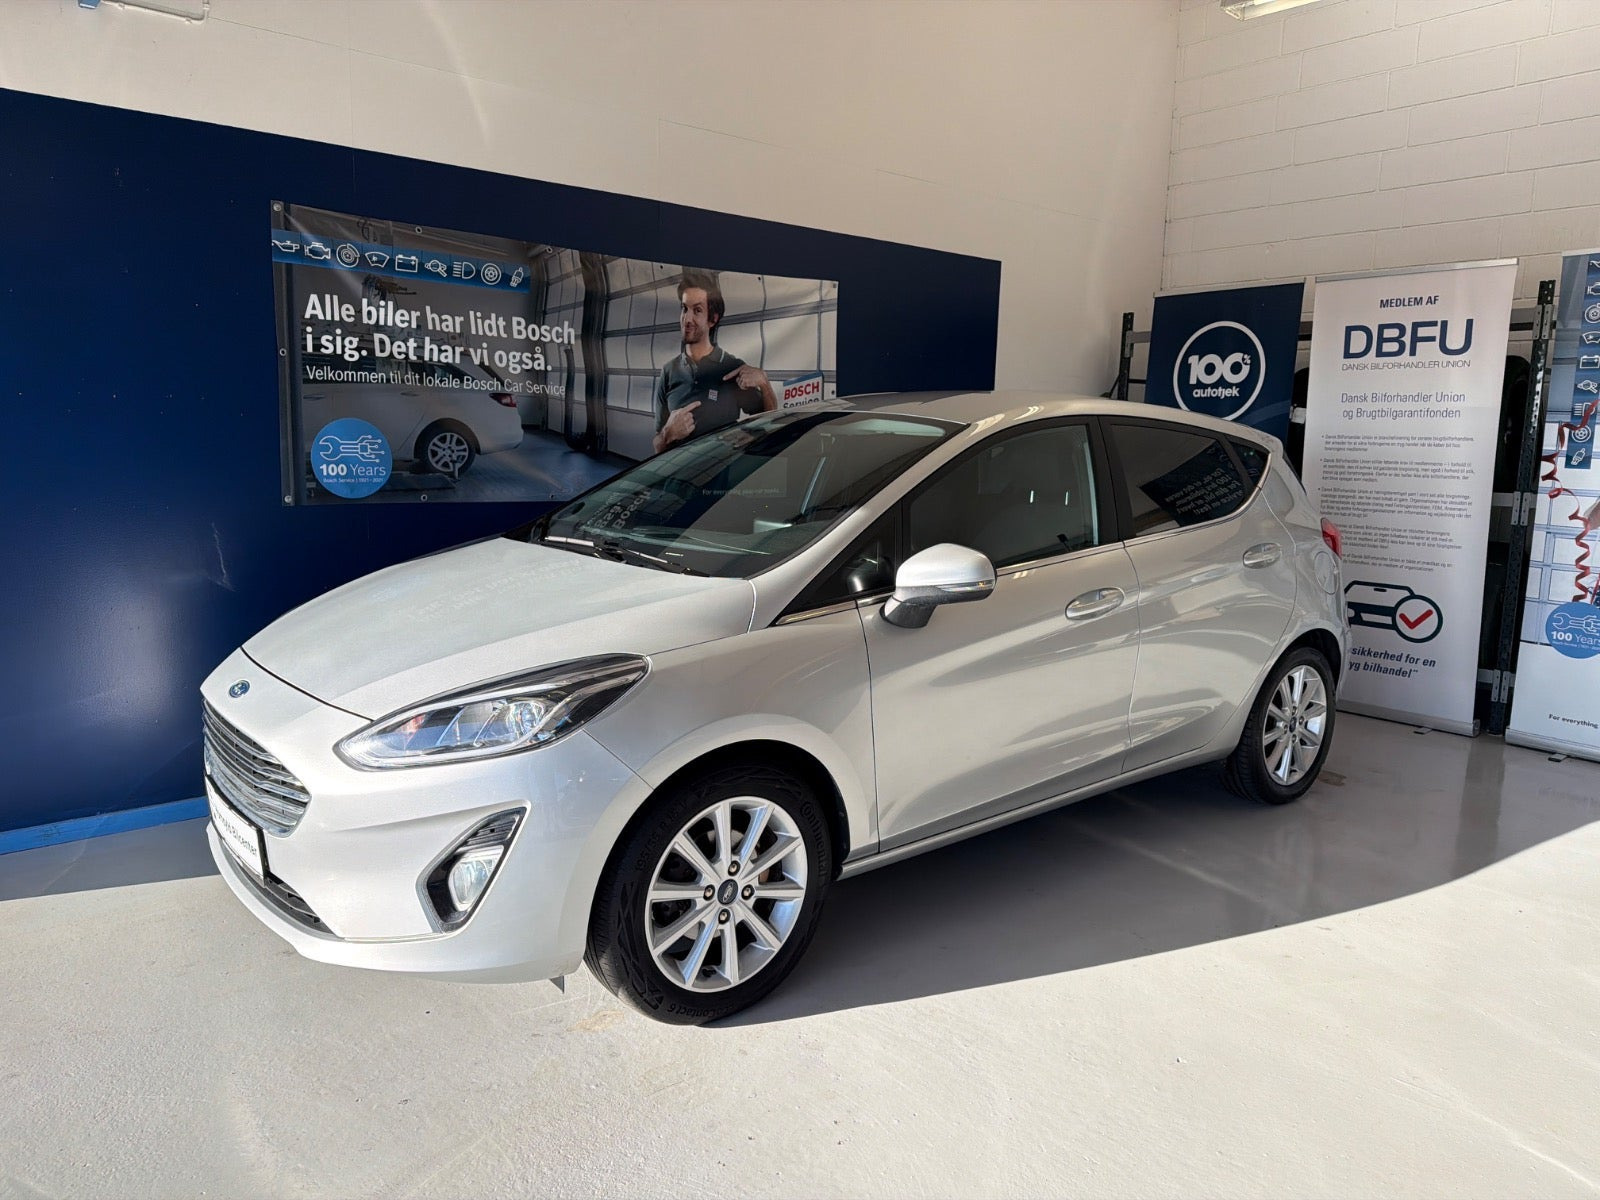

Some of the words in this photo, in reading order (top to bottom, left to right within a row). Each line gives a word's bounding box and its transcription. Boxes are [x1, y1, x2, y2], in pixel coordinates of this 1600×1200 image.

[1379, 296, 1424, 309] MEDLEM
[1425, 295, 1440, 306] AF
[304, 293, 355, 323] Alle
[361, 297, 421, 329] biler
[425, 305, 465, 334] har
[468, 310, 508, 338] lidt
[511, 316, 576, 345] Bosch
[1343, 318, 1474, 360] DBFU
[305, 326, 313, 353] i
[320, 328, 368, 362] sig.
[373, 332, 418, 361] Det
[424, 336, 465, 364] har
[468, 342, 489, 366] vi
[494, 346, 553, 375] også.
[1341, 362, 1370, 371] DANSK
[1370, 360, 1440, 371] BILFORHANDLER
[1440, 359, 1471, 369] UNION
[305, 365, 386, 384] Velkommen
[389, 370, 402, 385] til
[403, 371, 421, 386] dit
[423, 372, 460, 389] lokale
[463, 375, 501, 391] Bosch
[503, 378, 524, 393] Car
[525, 381, 566, 396] Service
[784, 381, 820, 401] BOSCH
[1192, 386, 1240, 400] autotjek
[1341, 392, 1369, 404] Dansk
[1371, 391, 1433, 404] Bilforhandler
[1435, 391, 1466, 402] Union
[1342, 409, 1354, 420] og
[1356, 407, 1461, 421] Brugtbilgarantifonden
[320, 463, 347, 477] 100
[349, 463, 386, 476] Years
[1551, 630, 1573, 642] 100
[1351, 646, 1403, 662] sikkerhed
[1404, 653, 1420, 665] for
[1422, 659, 1437, 668] en
[1348, 661, 1361, 672] yg
[1548, 713, 1560, 721] For
[1561, 717, 1599, 729] everything
